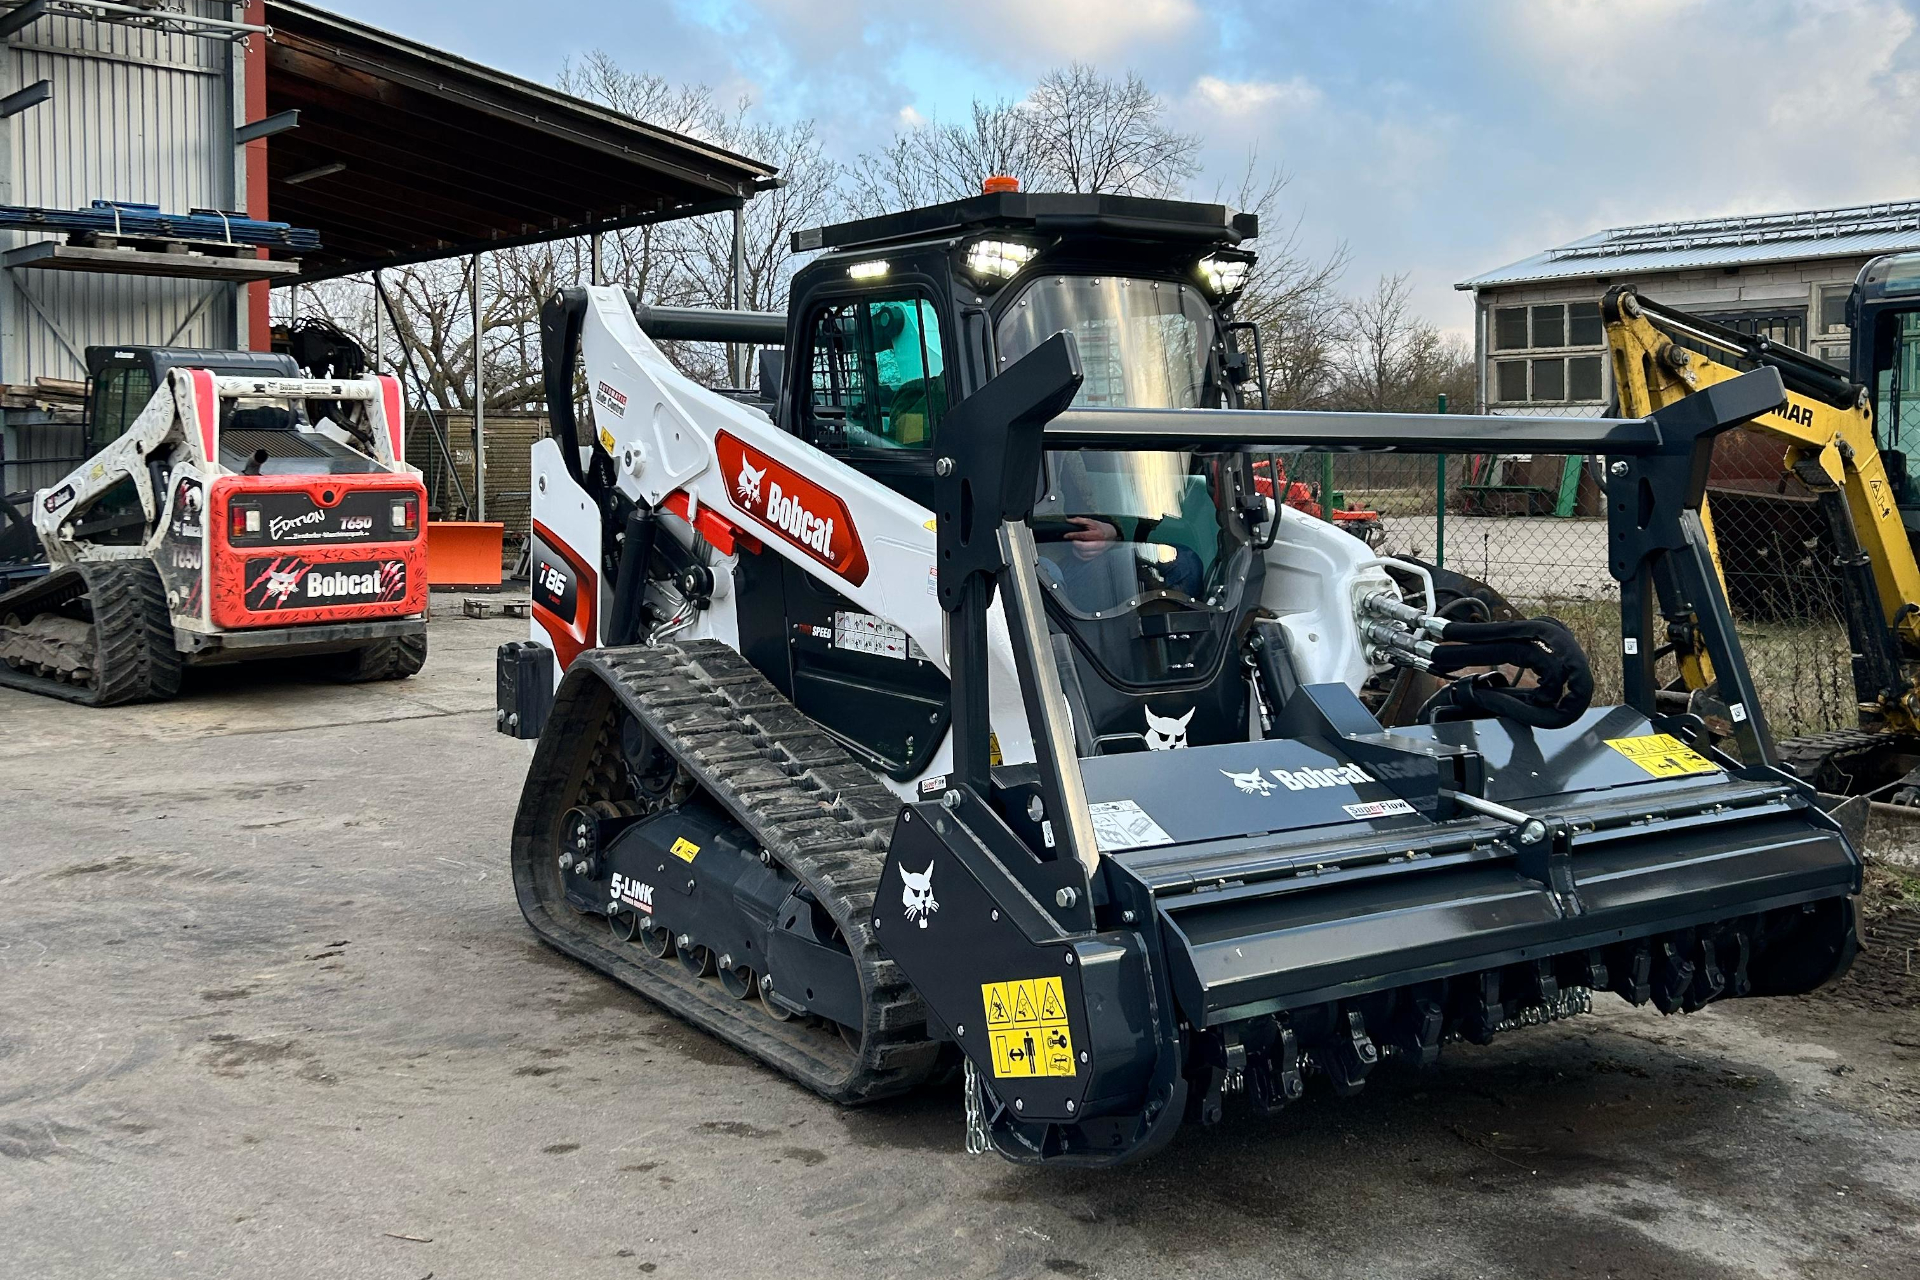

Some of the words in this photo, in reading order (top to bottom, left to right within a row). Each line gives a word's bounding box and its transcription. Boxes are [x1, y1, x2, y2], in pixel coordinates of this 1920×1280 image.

[1770, 402, 1814, 428] MAR
[268, 509, 326, 540] EDITION
[340, 516, 373, 530] T650
[766, 481, 834, 558] Bobcat
[307, 570, 383, 598] Bobcat
[539, 561, 568, 597] T86
[812, 625, 832, 639] SPEED
[1269, 762, 1376, 792] Bobcat
[1348, 801, 1407, 816] SuperFlow
